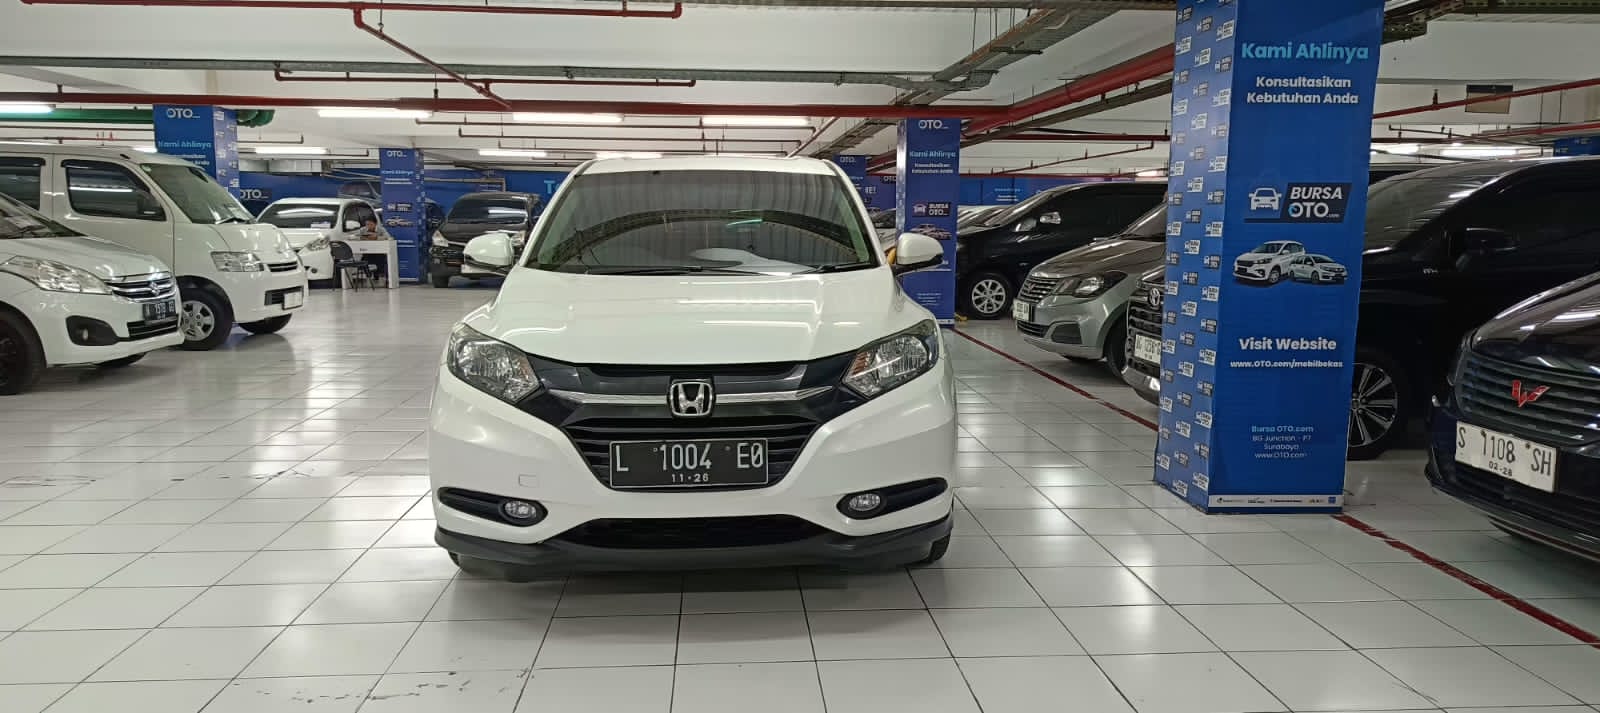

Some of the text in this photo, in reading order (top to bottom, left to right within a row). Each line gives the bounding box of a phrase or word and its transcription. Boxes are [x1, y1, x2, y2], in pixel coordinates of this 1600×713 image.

[1242, 42, 1369, 64] Kami Ahlinya
[1256, 76, 1352, 88] Konsultasikan
[1247, 92, 1359, 104] Kebutuhan Anda
[1290, 187, 1343, 200] BURSA
[1239, 337, 1337, 351] Visit Website
[1230, 359, 1344, 369] www.OTO.com/mobilbekas
[615, 445, 629, 472] L
[659, 443, 713, 471] 1004
[1458, 427, 1467, 449] S
[1530, 448, 1552, 476] SH
